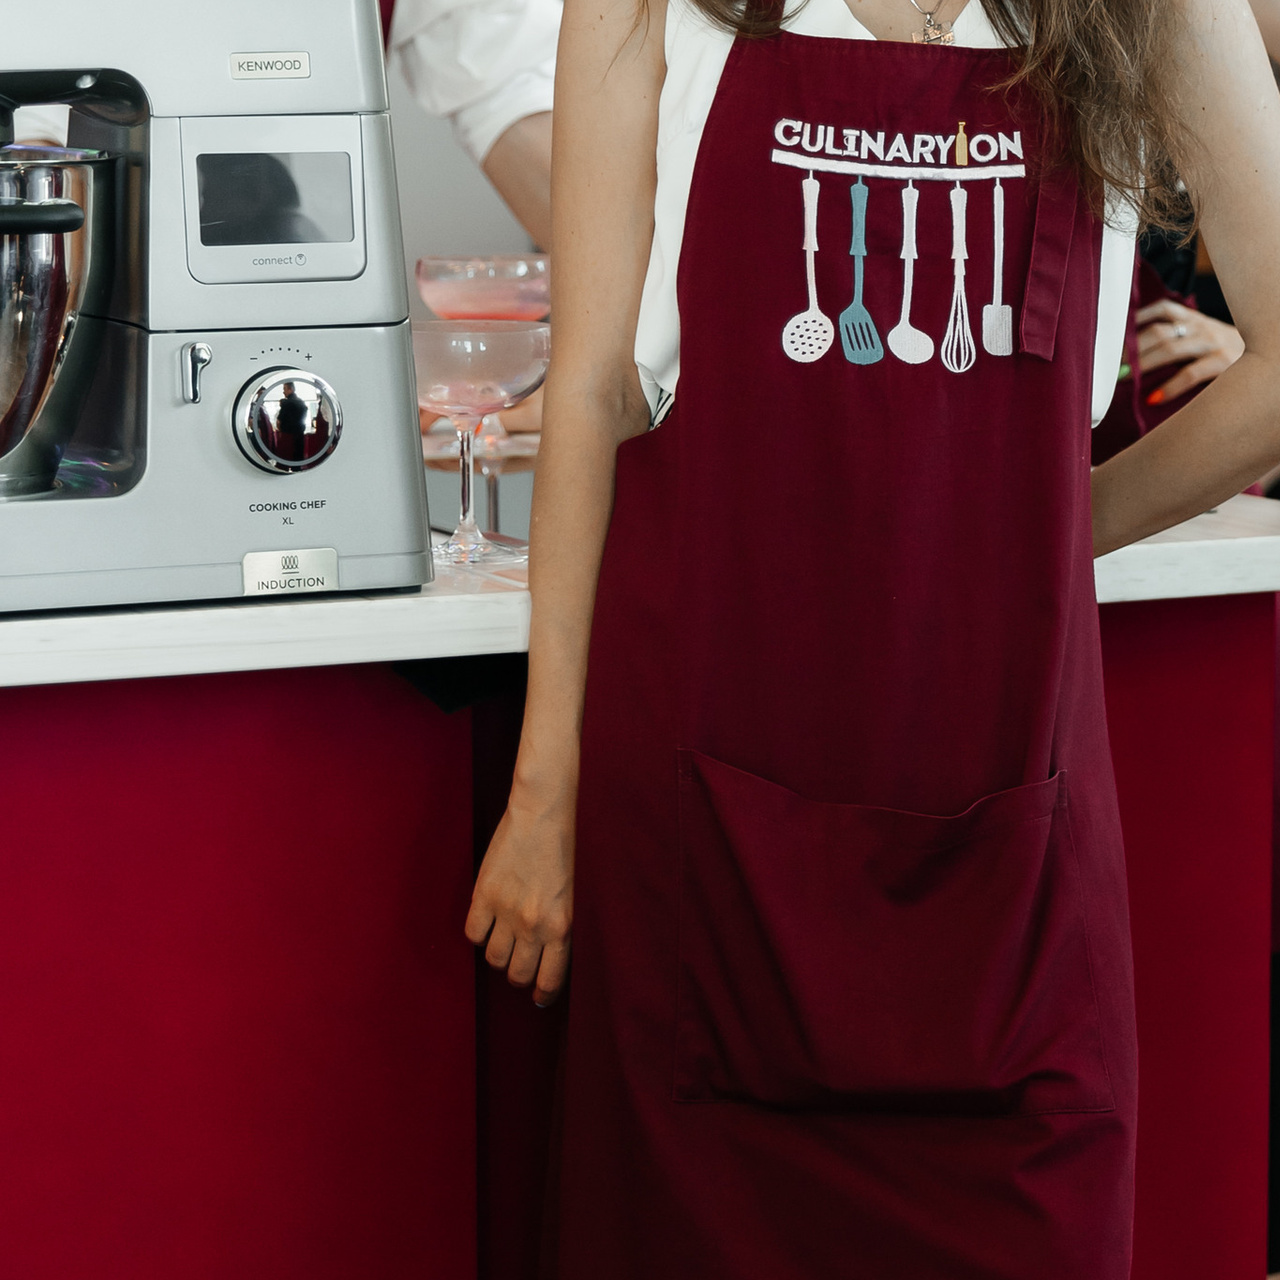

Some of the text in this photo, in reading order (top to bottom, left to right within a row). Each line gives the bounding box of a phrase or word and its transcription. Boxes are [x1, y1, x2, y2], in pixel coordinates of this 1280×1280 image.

[238, 59, 302, 72] KENWOOD
[252, 256, 293, 266] connect
[248, 499, 327, 513] COOKING CHEF
[282, 516, 295, 525] XL
[257, 576, 326, 591] INDUCTION
